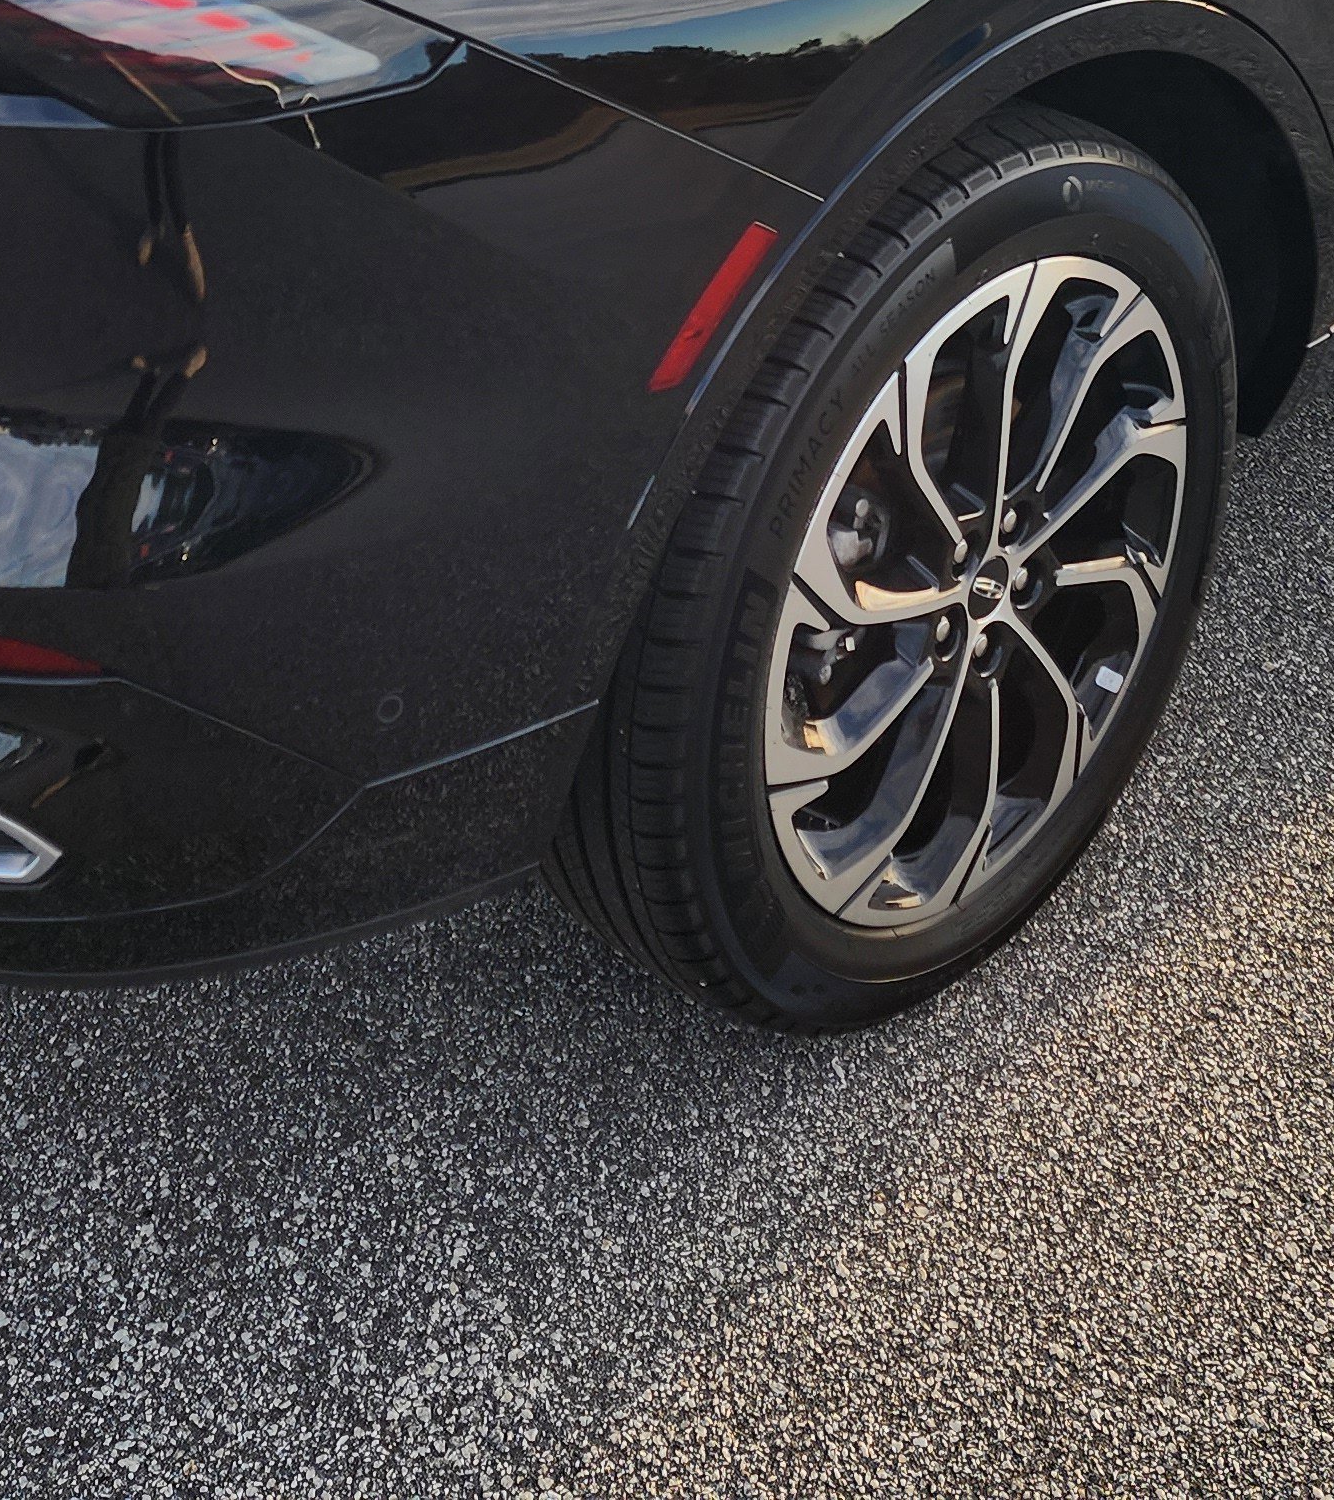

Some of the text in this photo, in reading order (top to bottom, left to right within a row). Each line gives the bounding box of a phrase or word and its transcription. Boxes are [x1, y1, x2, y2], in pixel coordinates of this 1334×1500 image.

[768, 271, 937, 540] PRIMACY ALL SEASON
